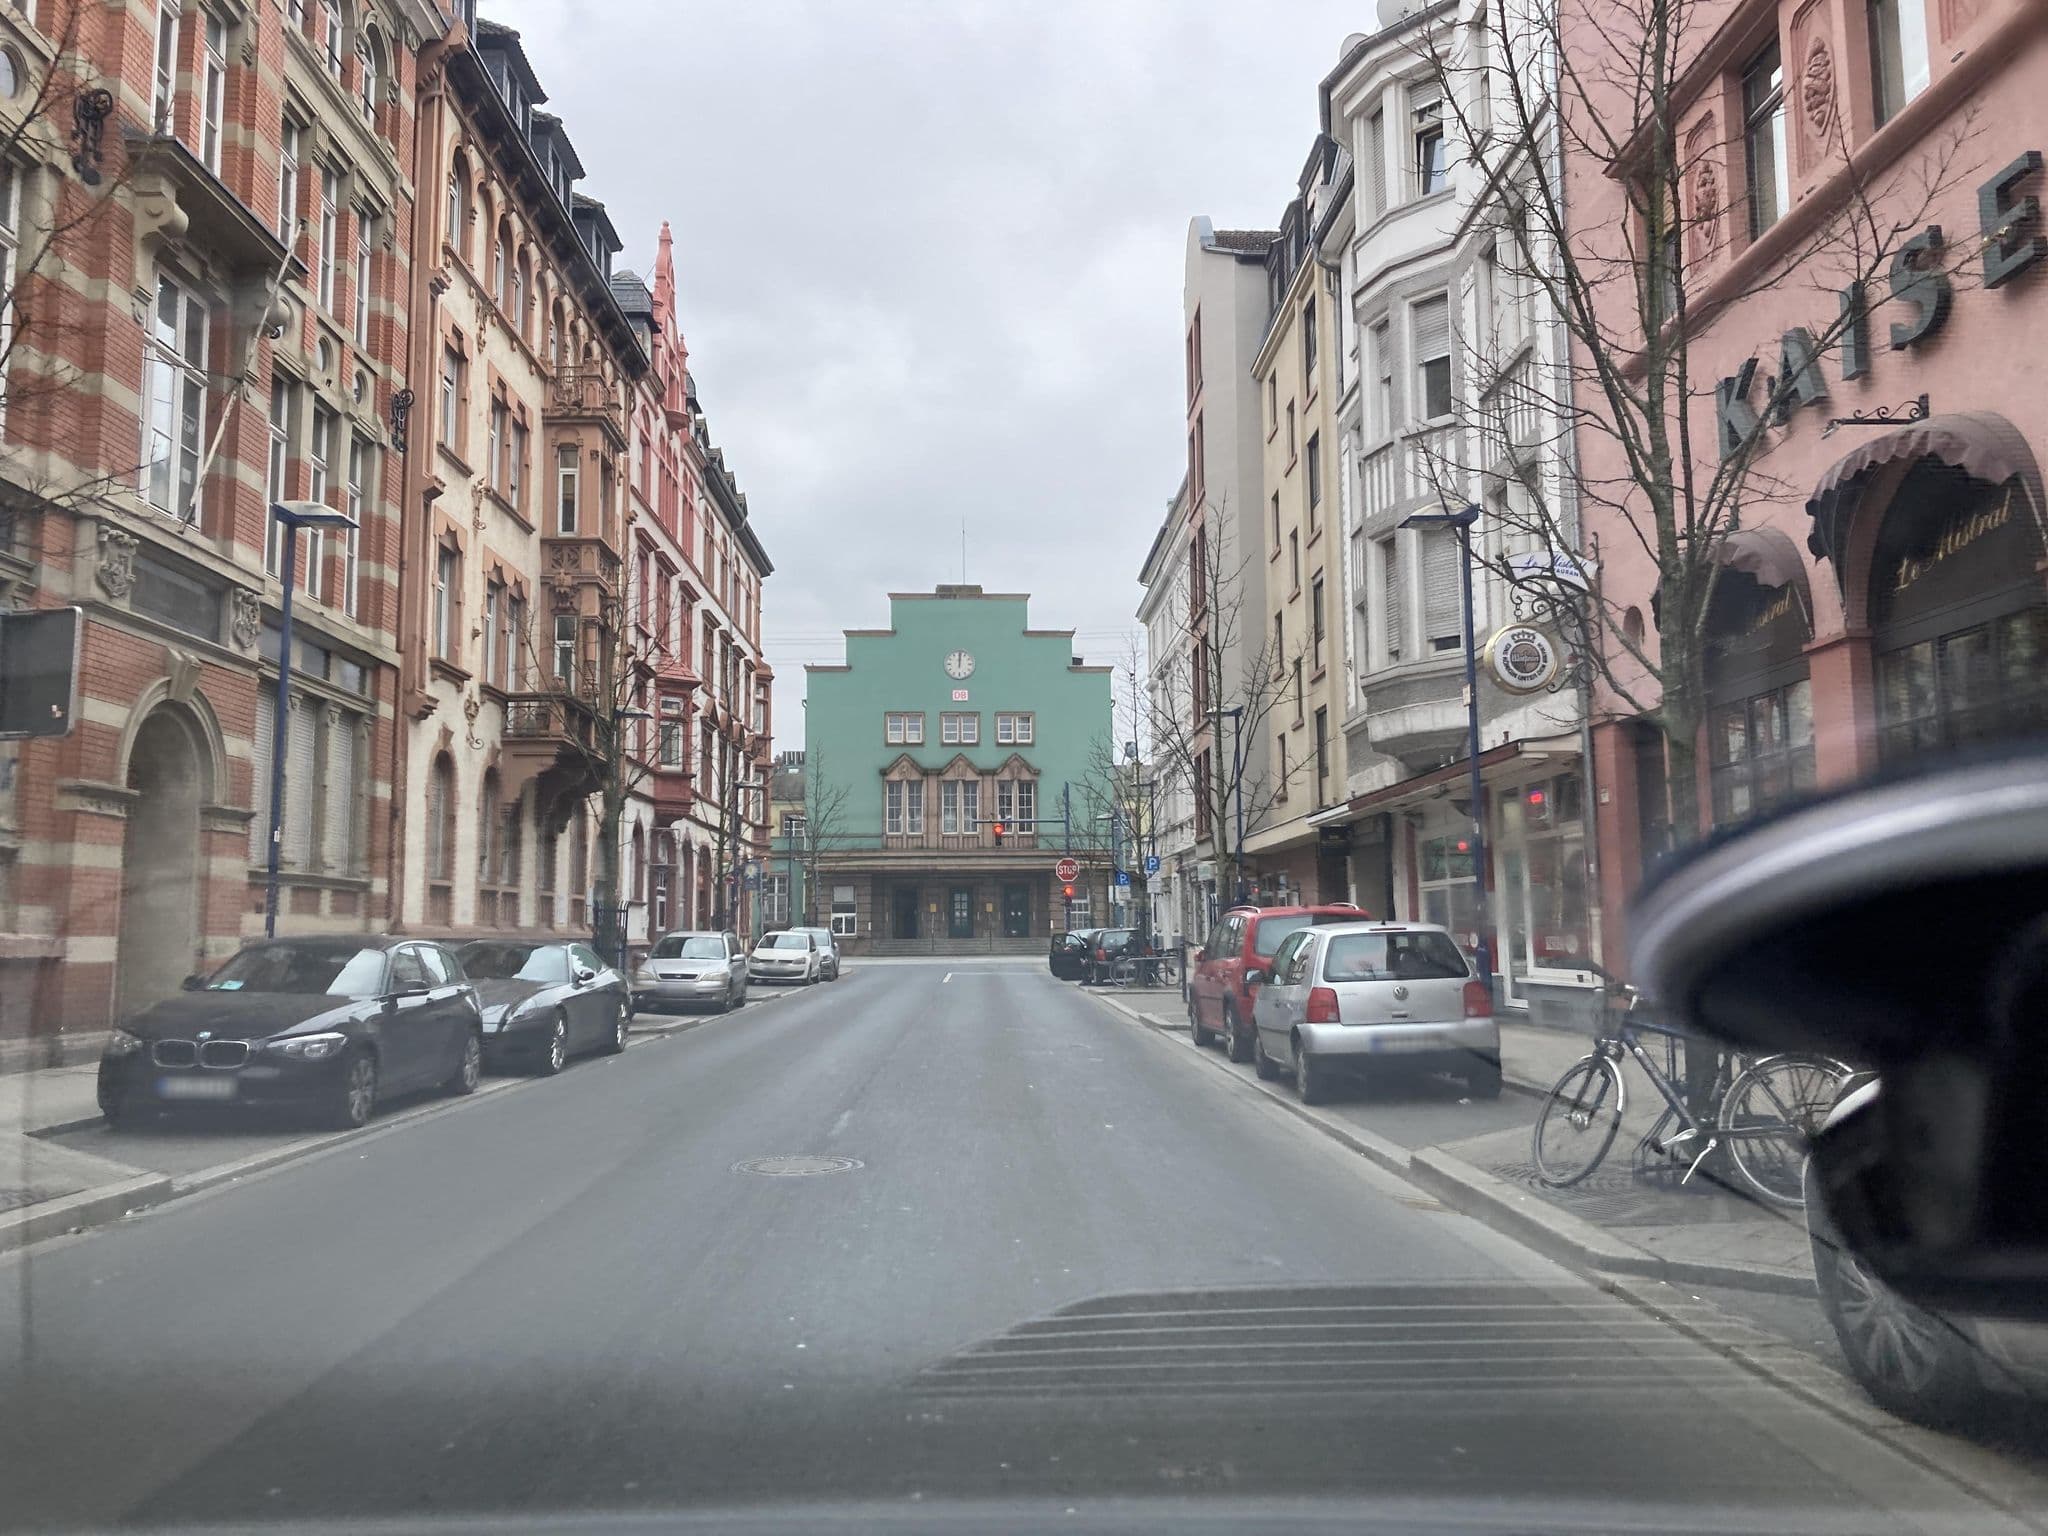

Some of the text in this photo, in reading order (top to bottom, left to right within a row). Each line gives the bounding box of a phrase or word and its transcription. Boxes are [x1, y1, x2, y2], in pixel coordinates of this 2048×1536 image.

[1715, 150, 2047, 467] KAISE
[954, 691, 967, 699] DB
[1149, 857, 1156, 869] P
[1058, 865, 1077, 875] STOP
[1120, 874, 1127, 885] P
